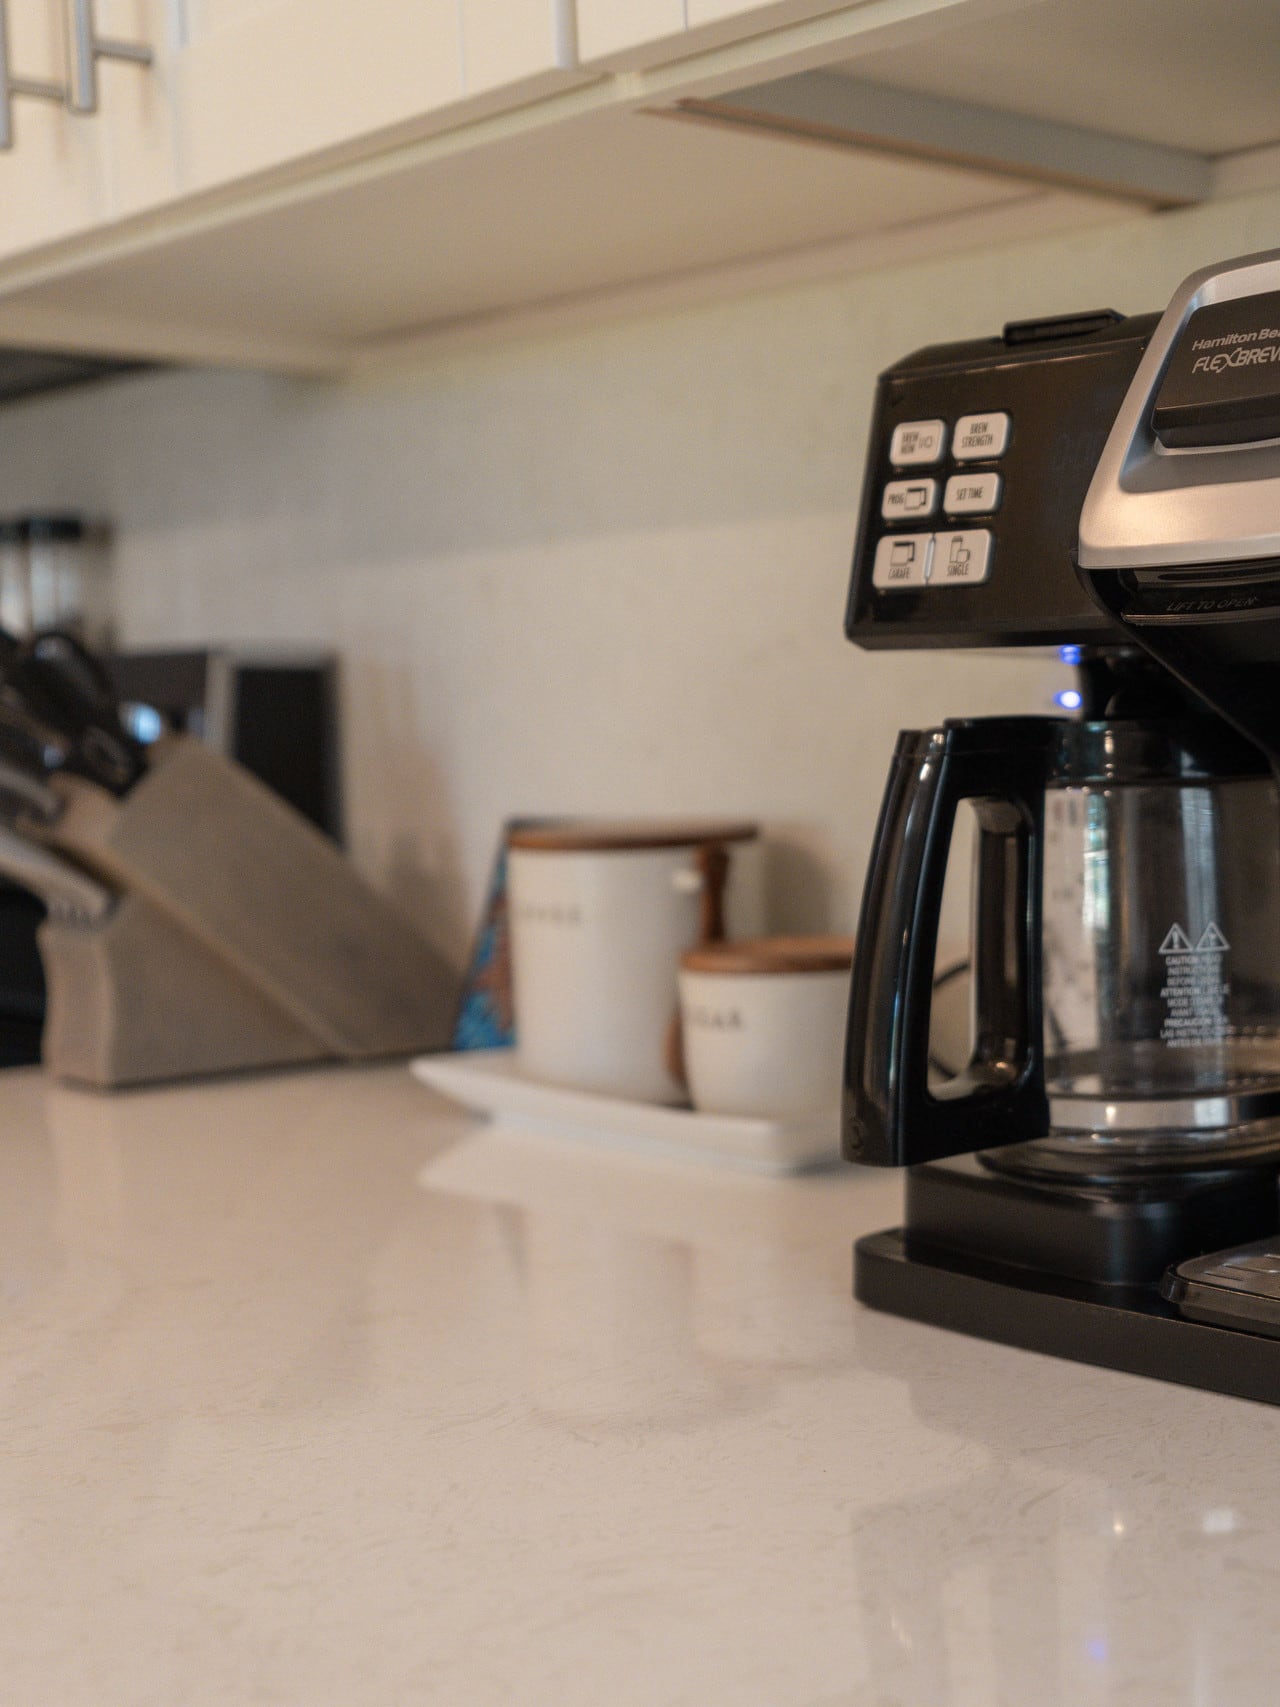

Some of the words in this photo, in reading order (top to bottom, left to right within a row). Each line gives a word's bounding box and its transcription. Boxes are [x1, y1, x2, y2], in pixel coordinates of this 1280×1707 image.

[1192, 331, 1258, 351] Hamilton
[970, 422, 988, 435] BREW
[961, 434, 993, 448] STRENGTH
[887, 493, 905, 505] PROG
[956, 489, 967, 501] SET
[967, 487, 984, 499] TIME
[888, 567, 910, 580] CARAFE
[947, 563, 970, 577] SINGLE
[1166, 600, 1194, 611] LIFT
[1197, 600, 1216, 610] TO
[1217, 598, 1255, 609] OPEN
[1165, 955, 1199, 965] CAUTION
[1160, 987, 1200, 997] ATTENTION
